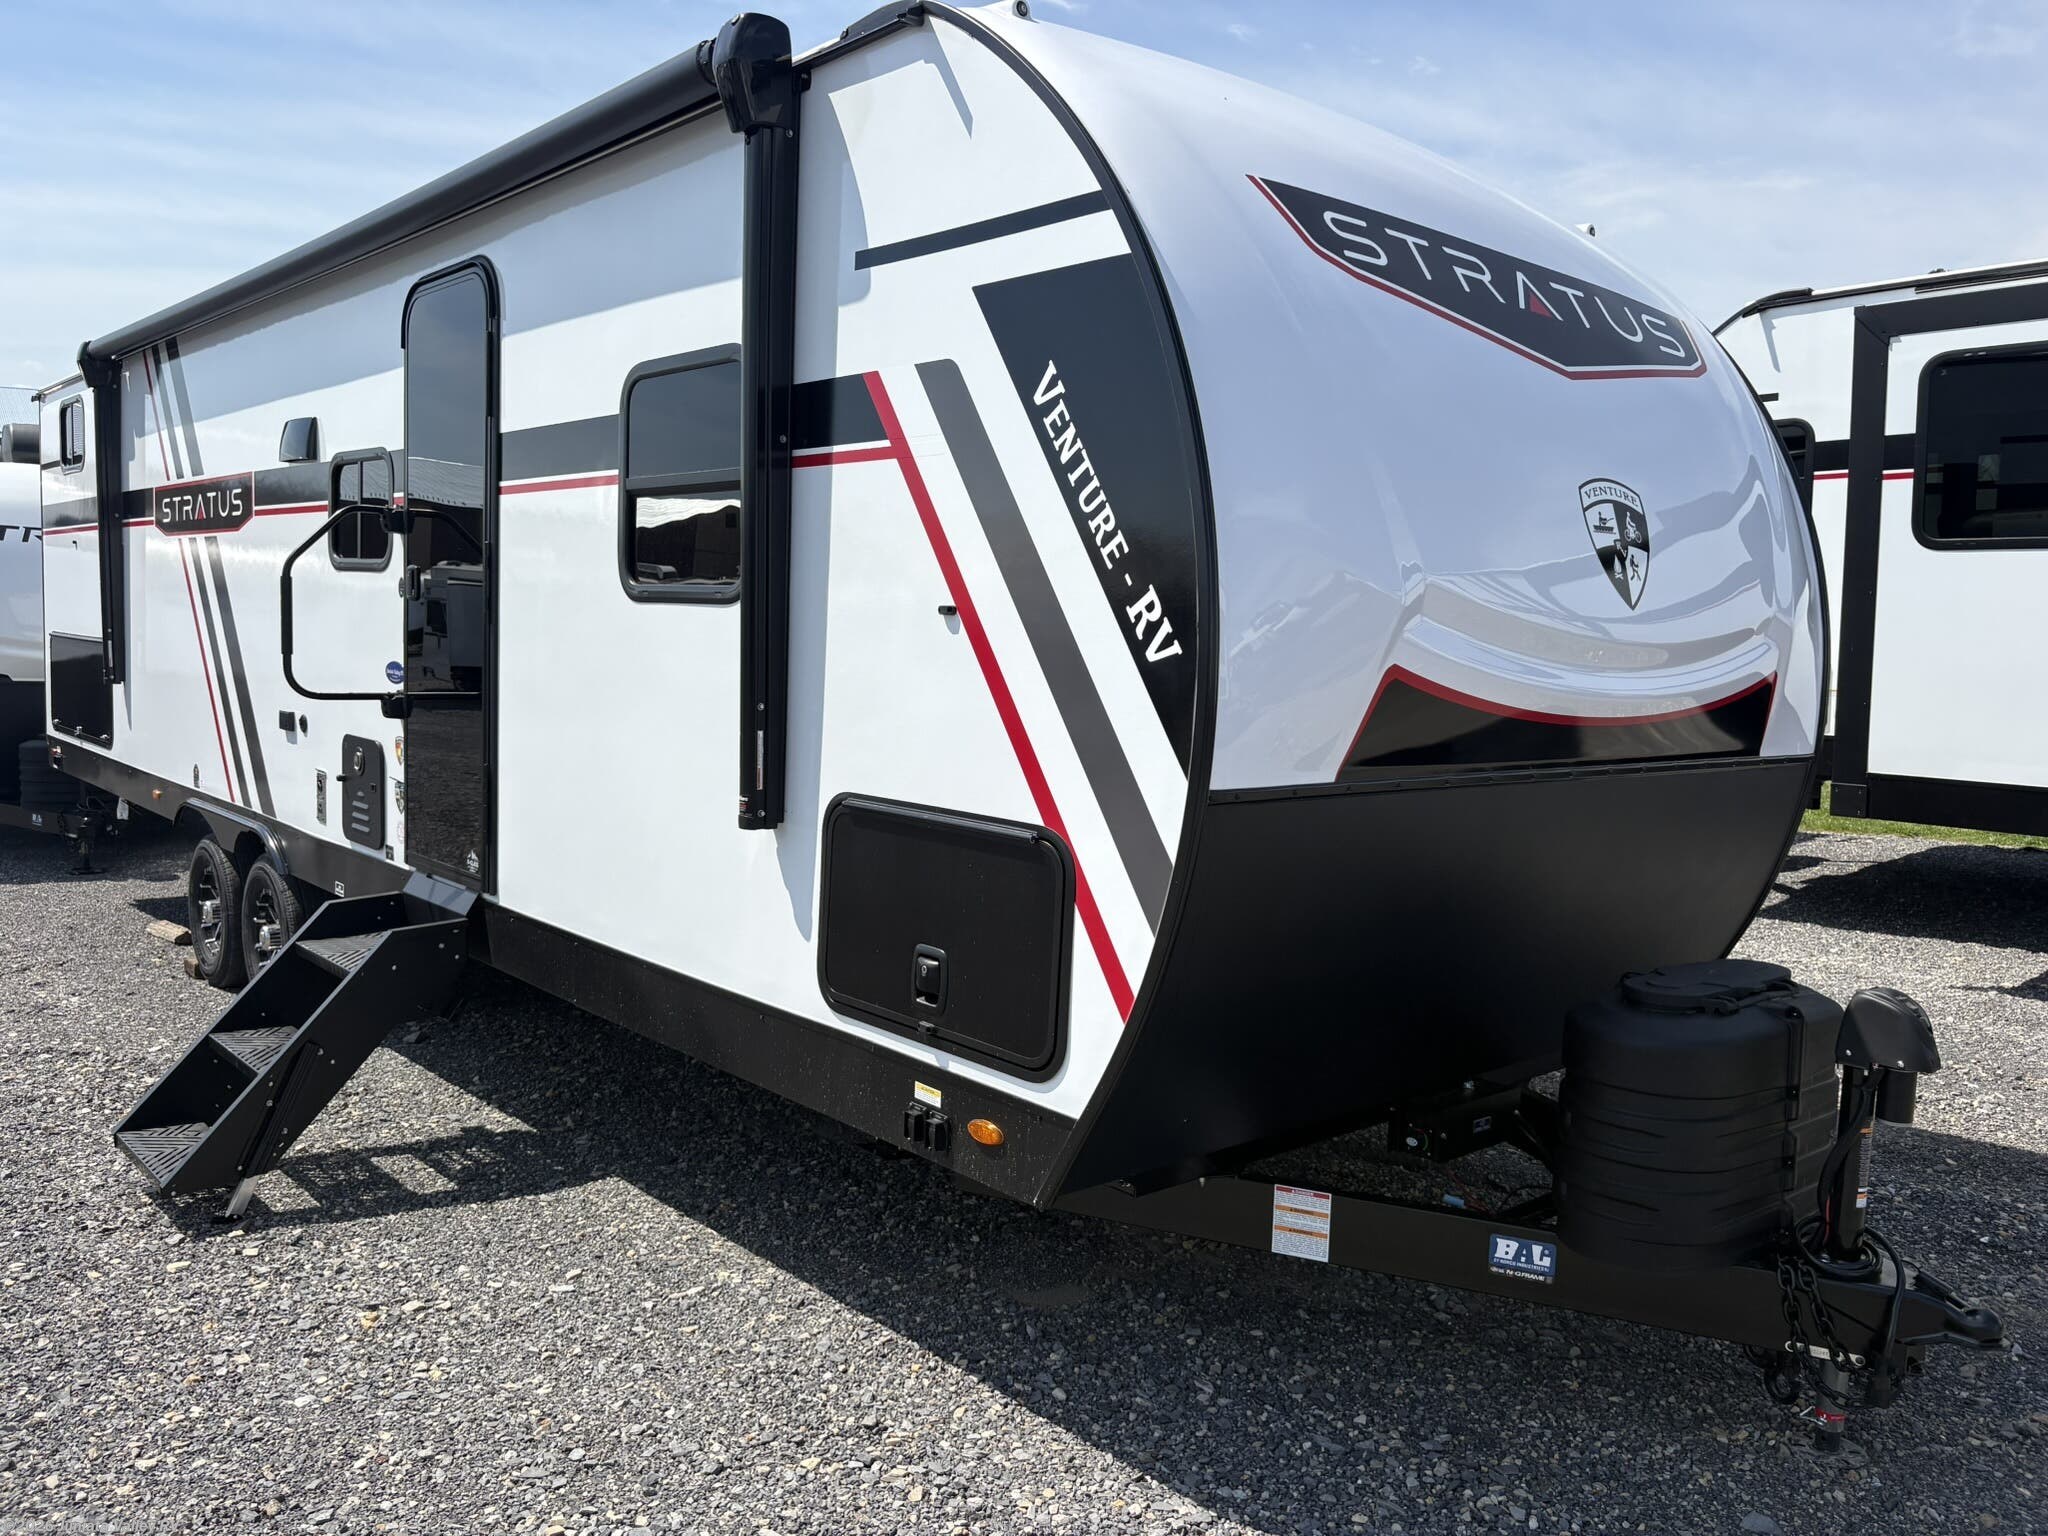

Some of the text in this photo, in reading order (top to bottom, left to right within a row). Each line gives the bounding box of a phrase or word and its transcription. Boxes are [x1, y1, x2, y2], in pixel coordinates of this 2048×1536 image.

[1322, 209, 1687, 359] STRATUS
[162, 488, 243, 524] STRATUS
[1584, 485, 1639, 508] VENTURE
[1125, 584, 1183, 663] RV
[1494, 1237, 1552, 1267] BAL
